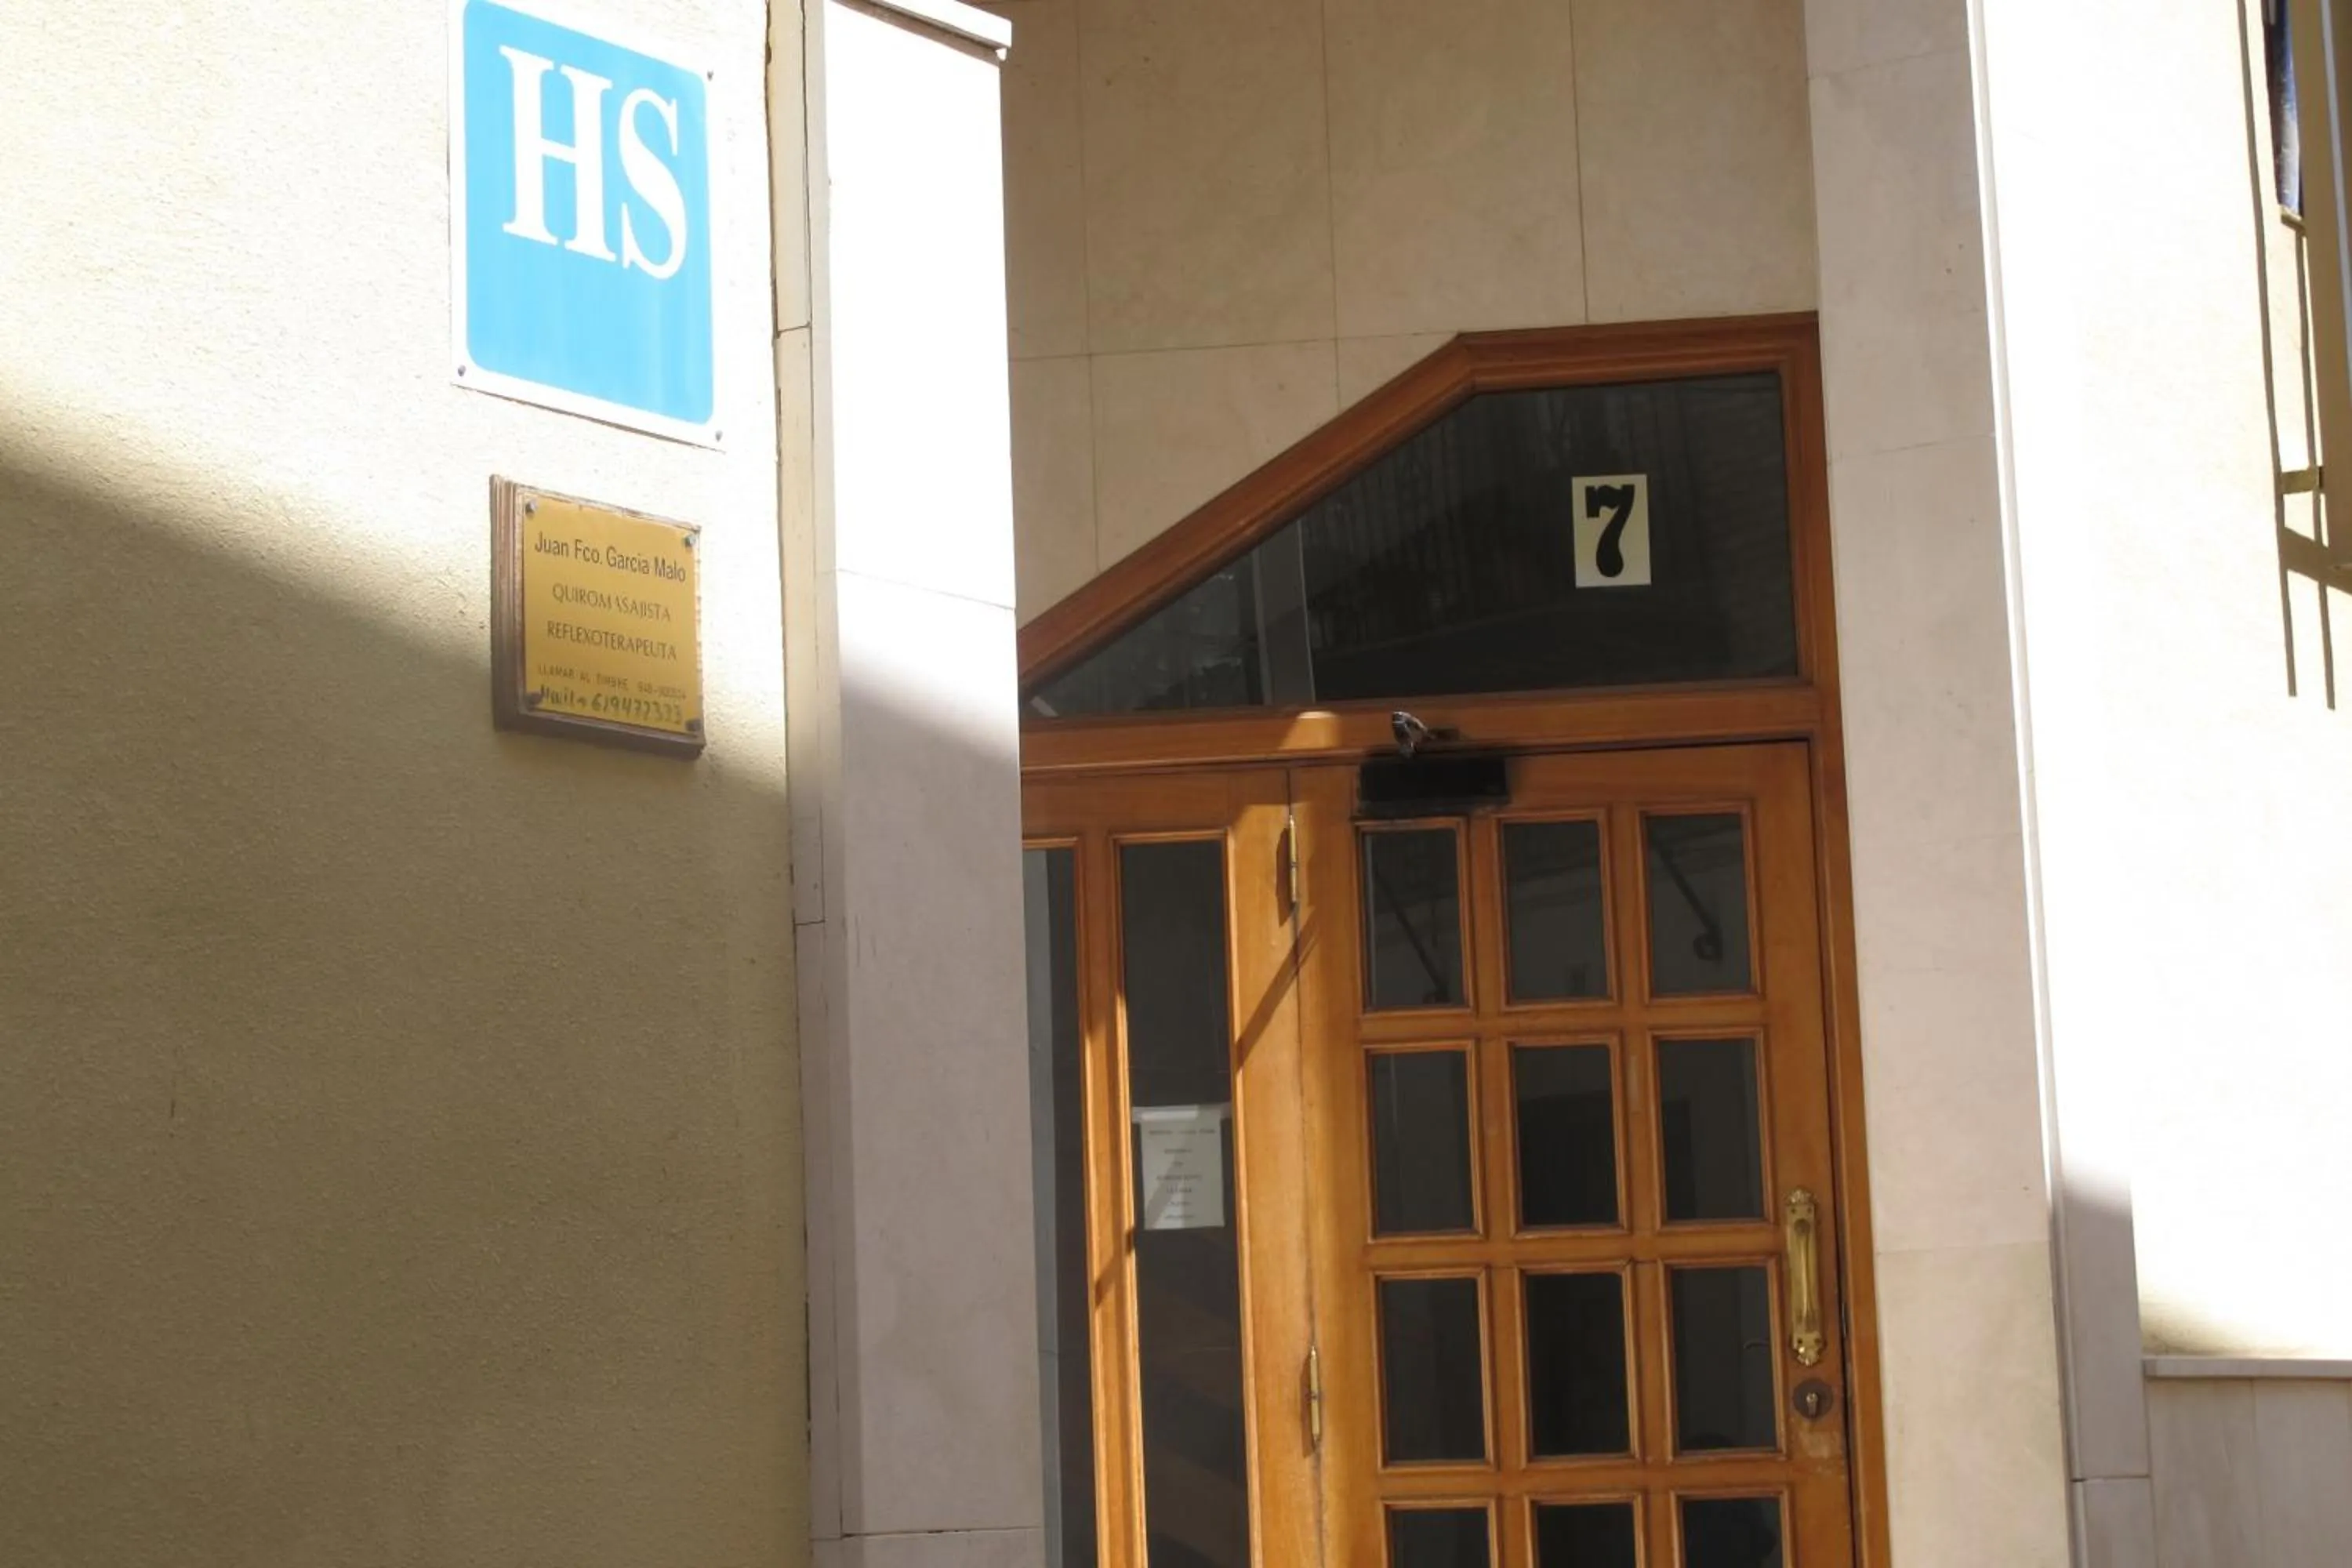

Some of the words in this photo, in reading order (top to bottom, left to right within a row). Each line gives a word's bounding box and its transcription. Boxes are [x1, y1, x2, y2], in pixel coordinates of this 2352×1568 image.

[499, 44, 688, 280] HS
[535, 531, 569, 558] Juan
[574, 539, 603, 565] Fco.
[654, 554, 686, 583] Malo
[1584, 484, 1635, 578] 7
[552, 583, 671, 622] QUIROMASAJISTA
[546, 620, 677, 660] REFLEXOTERAPEUTA
